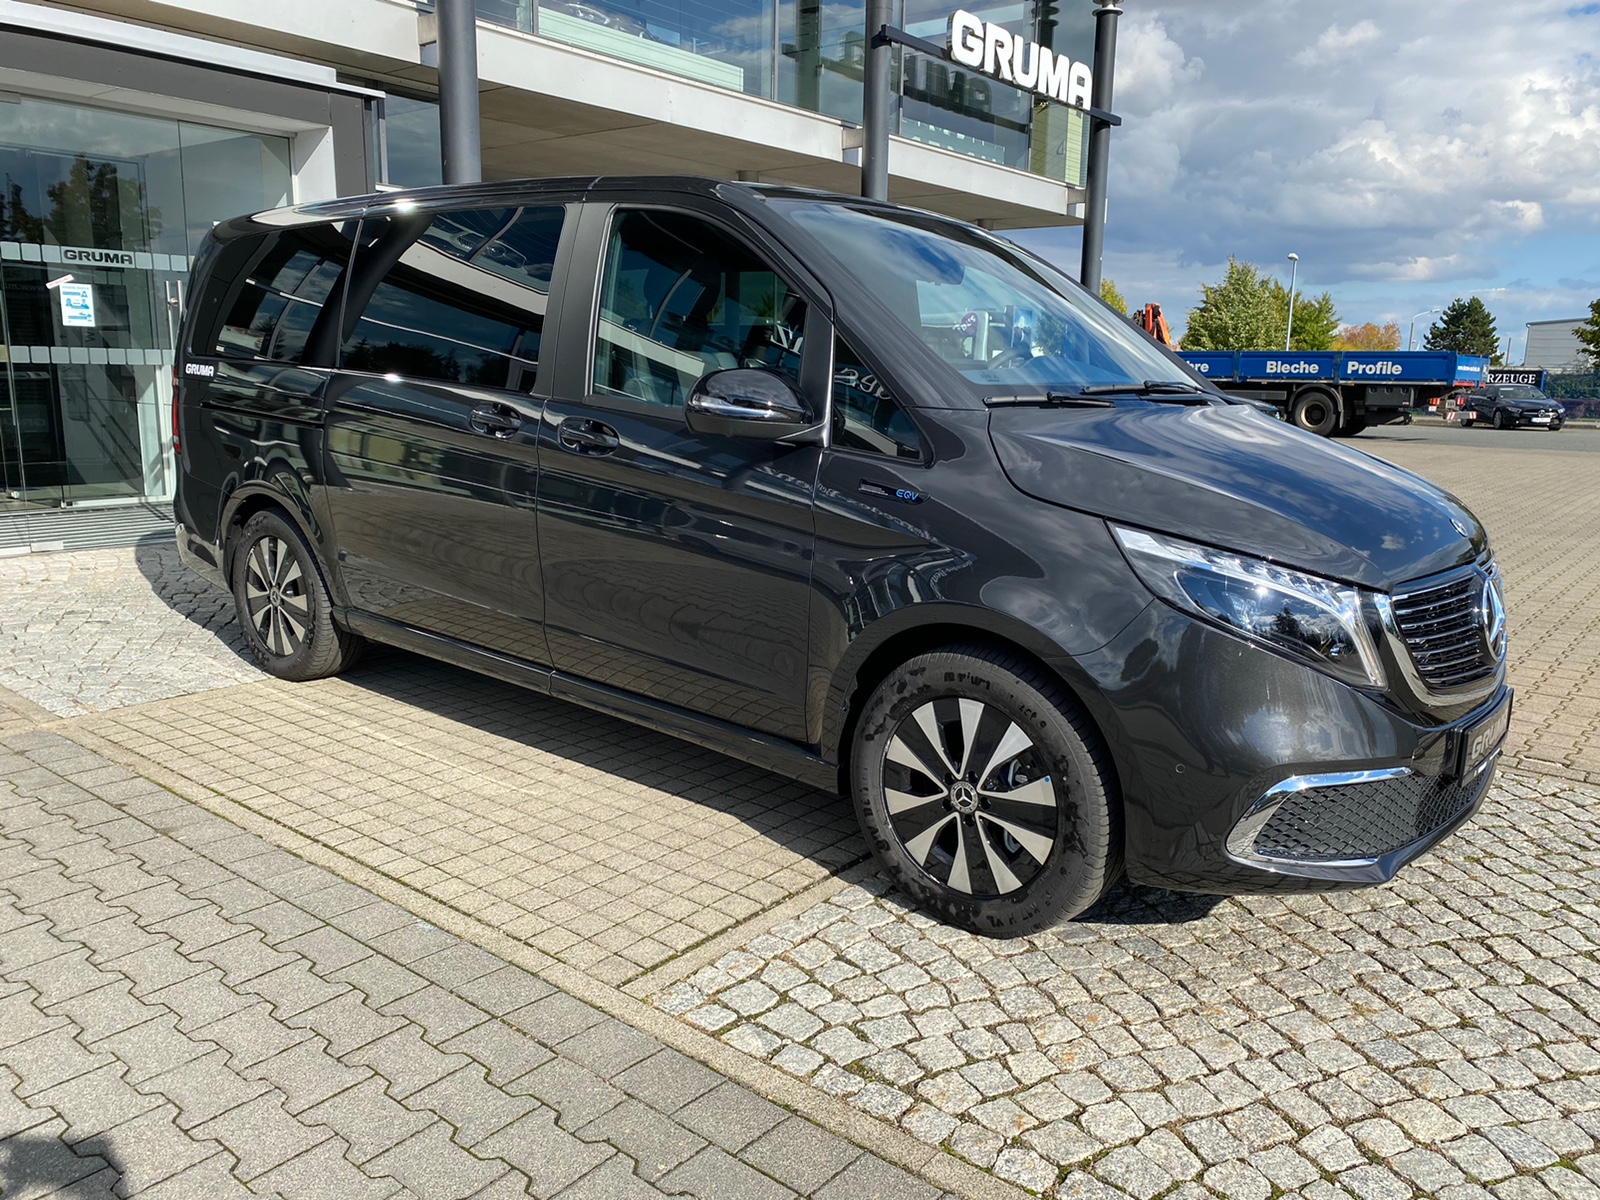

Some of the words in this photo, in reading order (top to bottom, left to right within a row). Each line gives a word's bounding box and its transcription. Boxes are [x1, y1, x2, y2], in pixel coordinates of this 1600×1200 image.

[951, 9, 1093, 111] GRUMA
[63, 249, 133, 264] GRUMA
[185, 363, 214, 377] GRUMA
[1266, 361, 1320, 374] Bleche
[1346, 361, 1403, 375] Profile
[1486, 373, 1537, 384] RZEUGE
[896, 489, 919, 500] EQV
